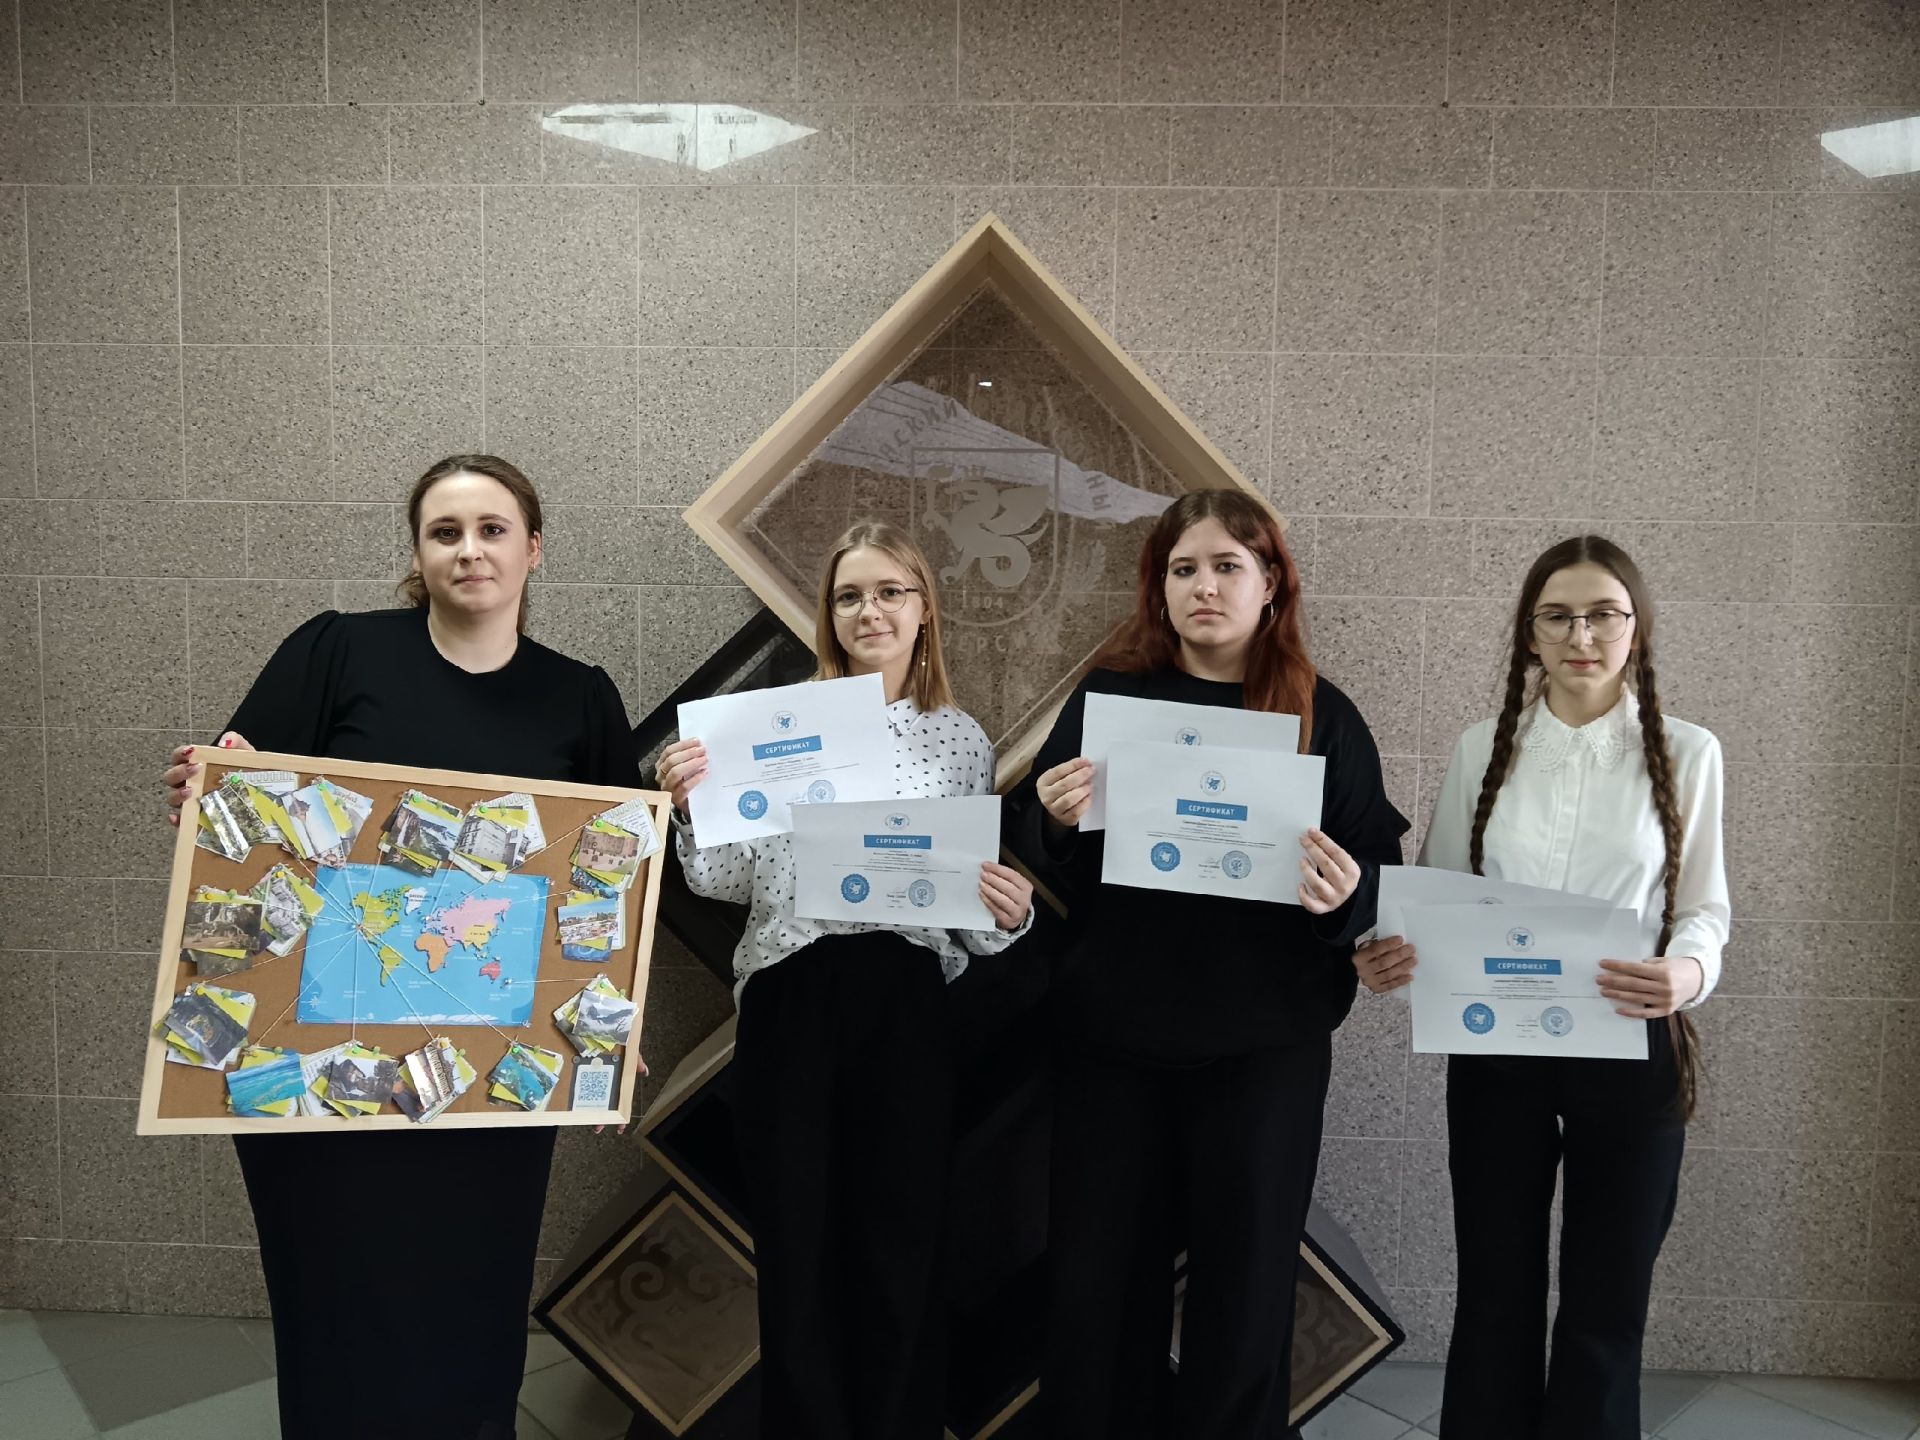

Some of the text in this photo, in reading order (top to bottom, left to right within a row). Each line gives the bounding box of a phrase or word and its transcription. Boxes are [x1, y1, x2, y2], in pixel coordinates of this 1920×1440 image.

[962, 596, 1004, 609] 1804
[765, 741, 810, 755] СЕРТИФИКАТ
[1189, 805, 1235, 816] СЕРТИФИКАТ
[876, 838, 921, 846] СЕРТИФИКАТ
[1497, 963, 1548, 971] СЕРТИФИКАТ
